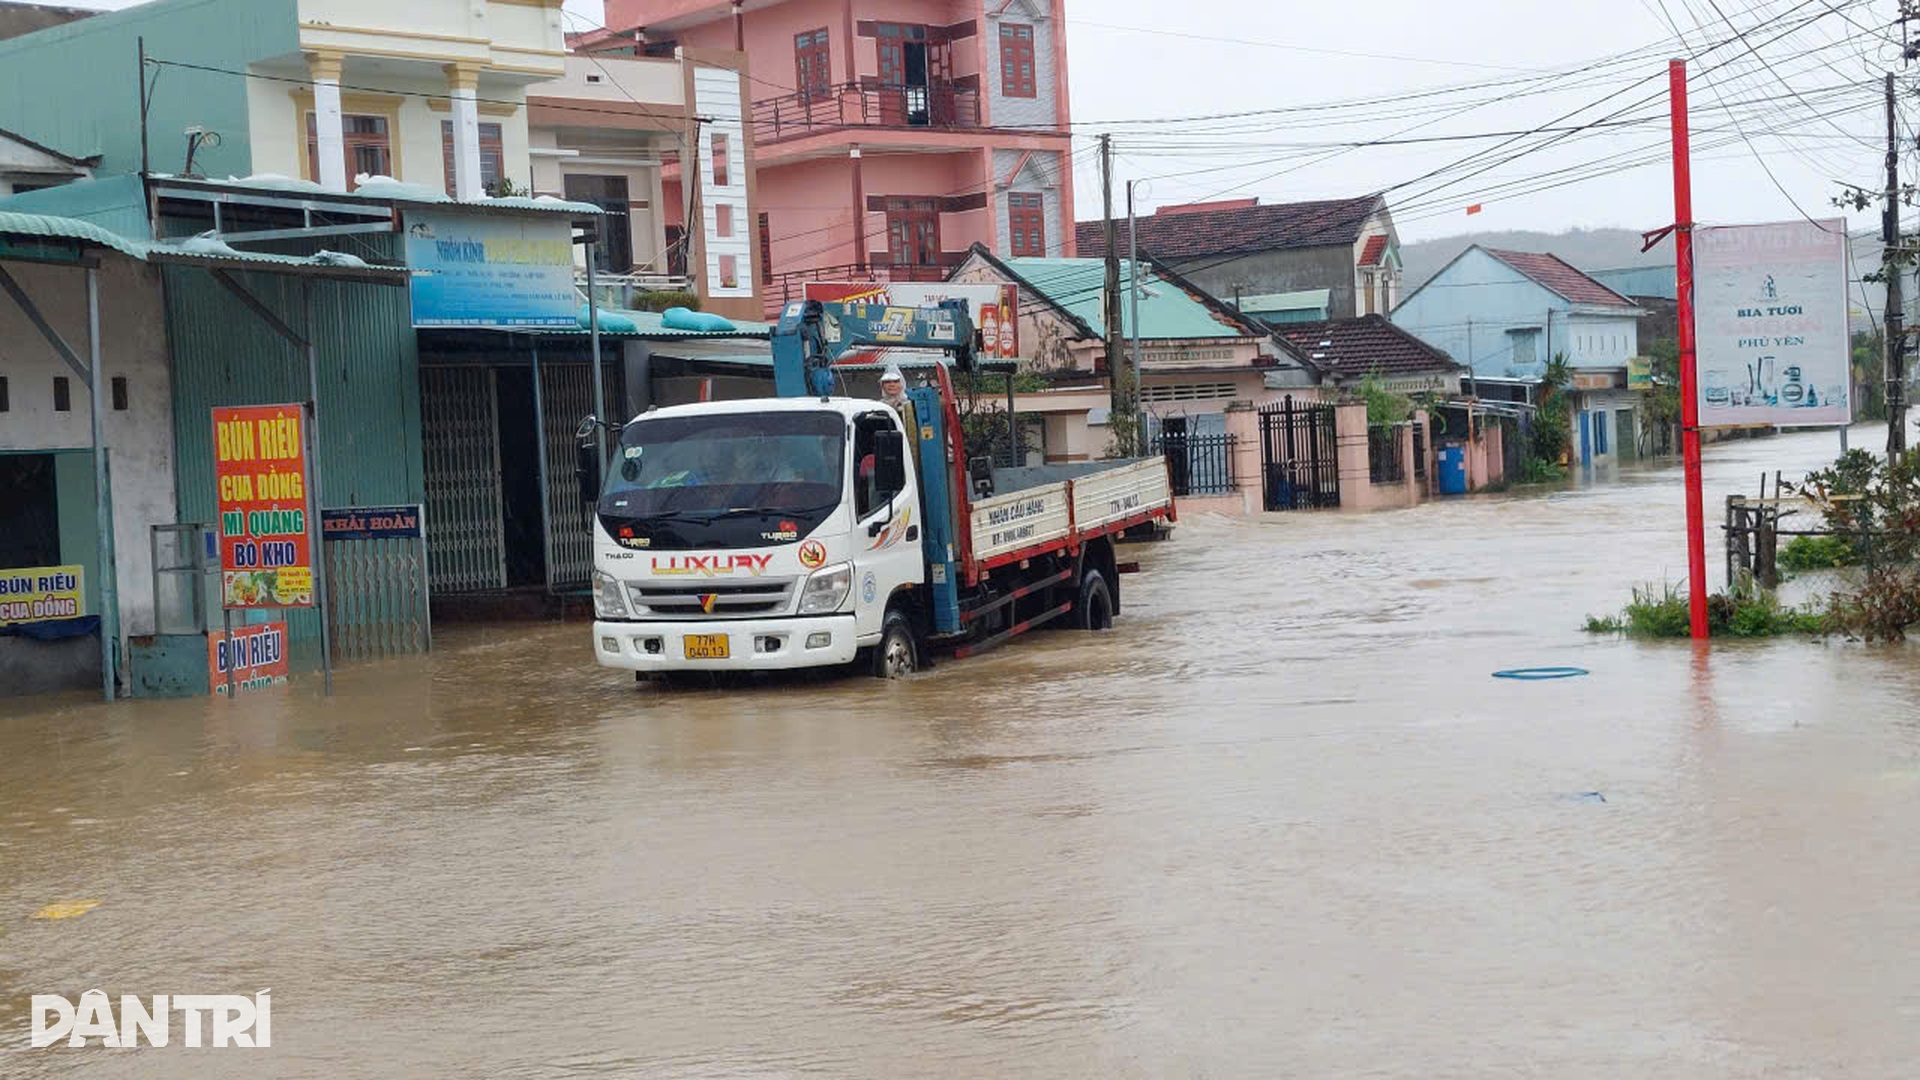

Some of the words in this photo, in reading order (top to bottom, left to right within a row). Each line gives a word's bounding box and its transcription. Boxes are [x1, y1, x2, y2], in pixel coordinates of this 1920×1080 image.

[1737, 308, 1762, 318] BIA
[1767, 305, 1802, 316] TƯƠI
[1738, 336, 1769, 348] PHÚ
[1774, 335, 1804, 346] YÊN
[217, 414, 256, 461] BÚN
[258, 411, 300, 460] RIÊU
[220, 475, 254, 501] CUA
[257, 464, 302, 501] ĐỒNG
[222, 507, 245, 536] MÌ
[248, 503, 305, 538] QUẢNG
[370, 514, 416, 530] HOÀN
[620, 538, 650, 547] TURBO
[761, 532, 798, 541] TURBO
[233, 538, 258, 567] BÒ
[261, 541, 297, 567] KHO
[651, 554, 773, 577] LUXURY
[0, 576, 32, 594] BÚN
[38, 572, 76, 592] RIÊU
[0, 601, 31, 620] CUA
[33, 593, 77, 618] ĐỒNG
[250, 626, 281, 666] RIÊU
[695, 635, 715, 646] 77H
